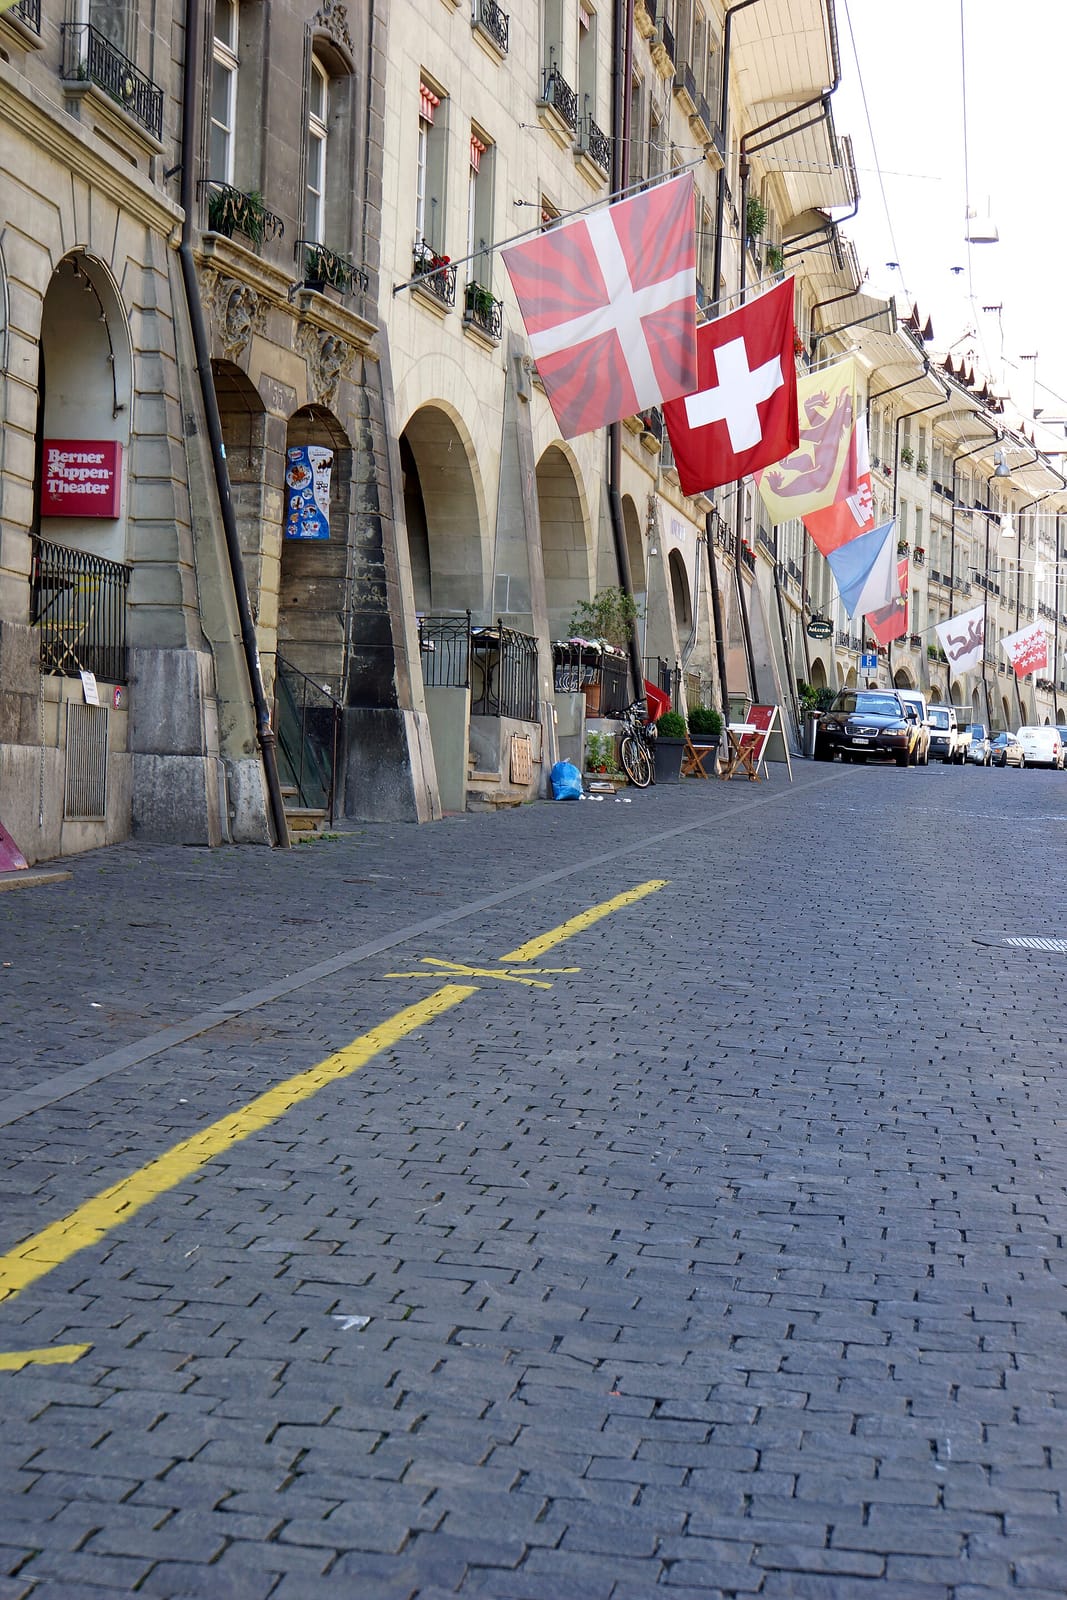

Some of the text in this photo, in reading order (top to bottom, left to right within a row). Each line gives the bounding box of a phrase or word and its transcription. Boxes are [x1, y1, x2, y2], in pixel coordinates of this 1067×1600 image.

[48, 449, 105, 464] Berner
[47, 463, 113, 481] Puppen-
[47, 479, 109, 495] Theater
